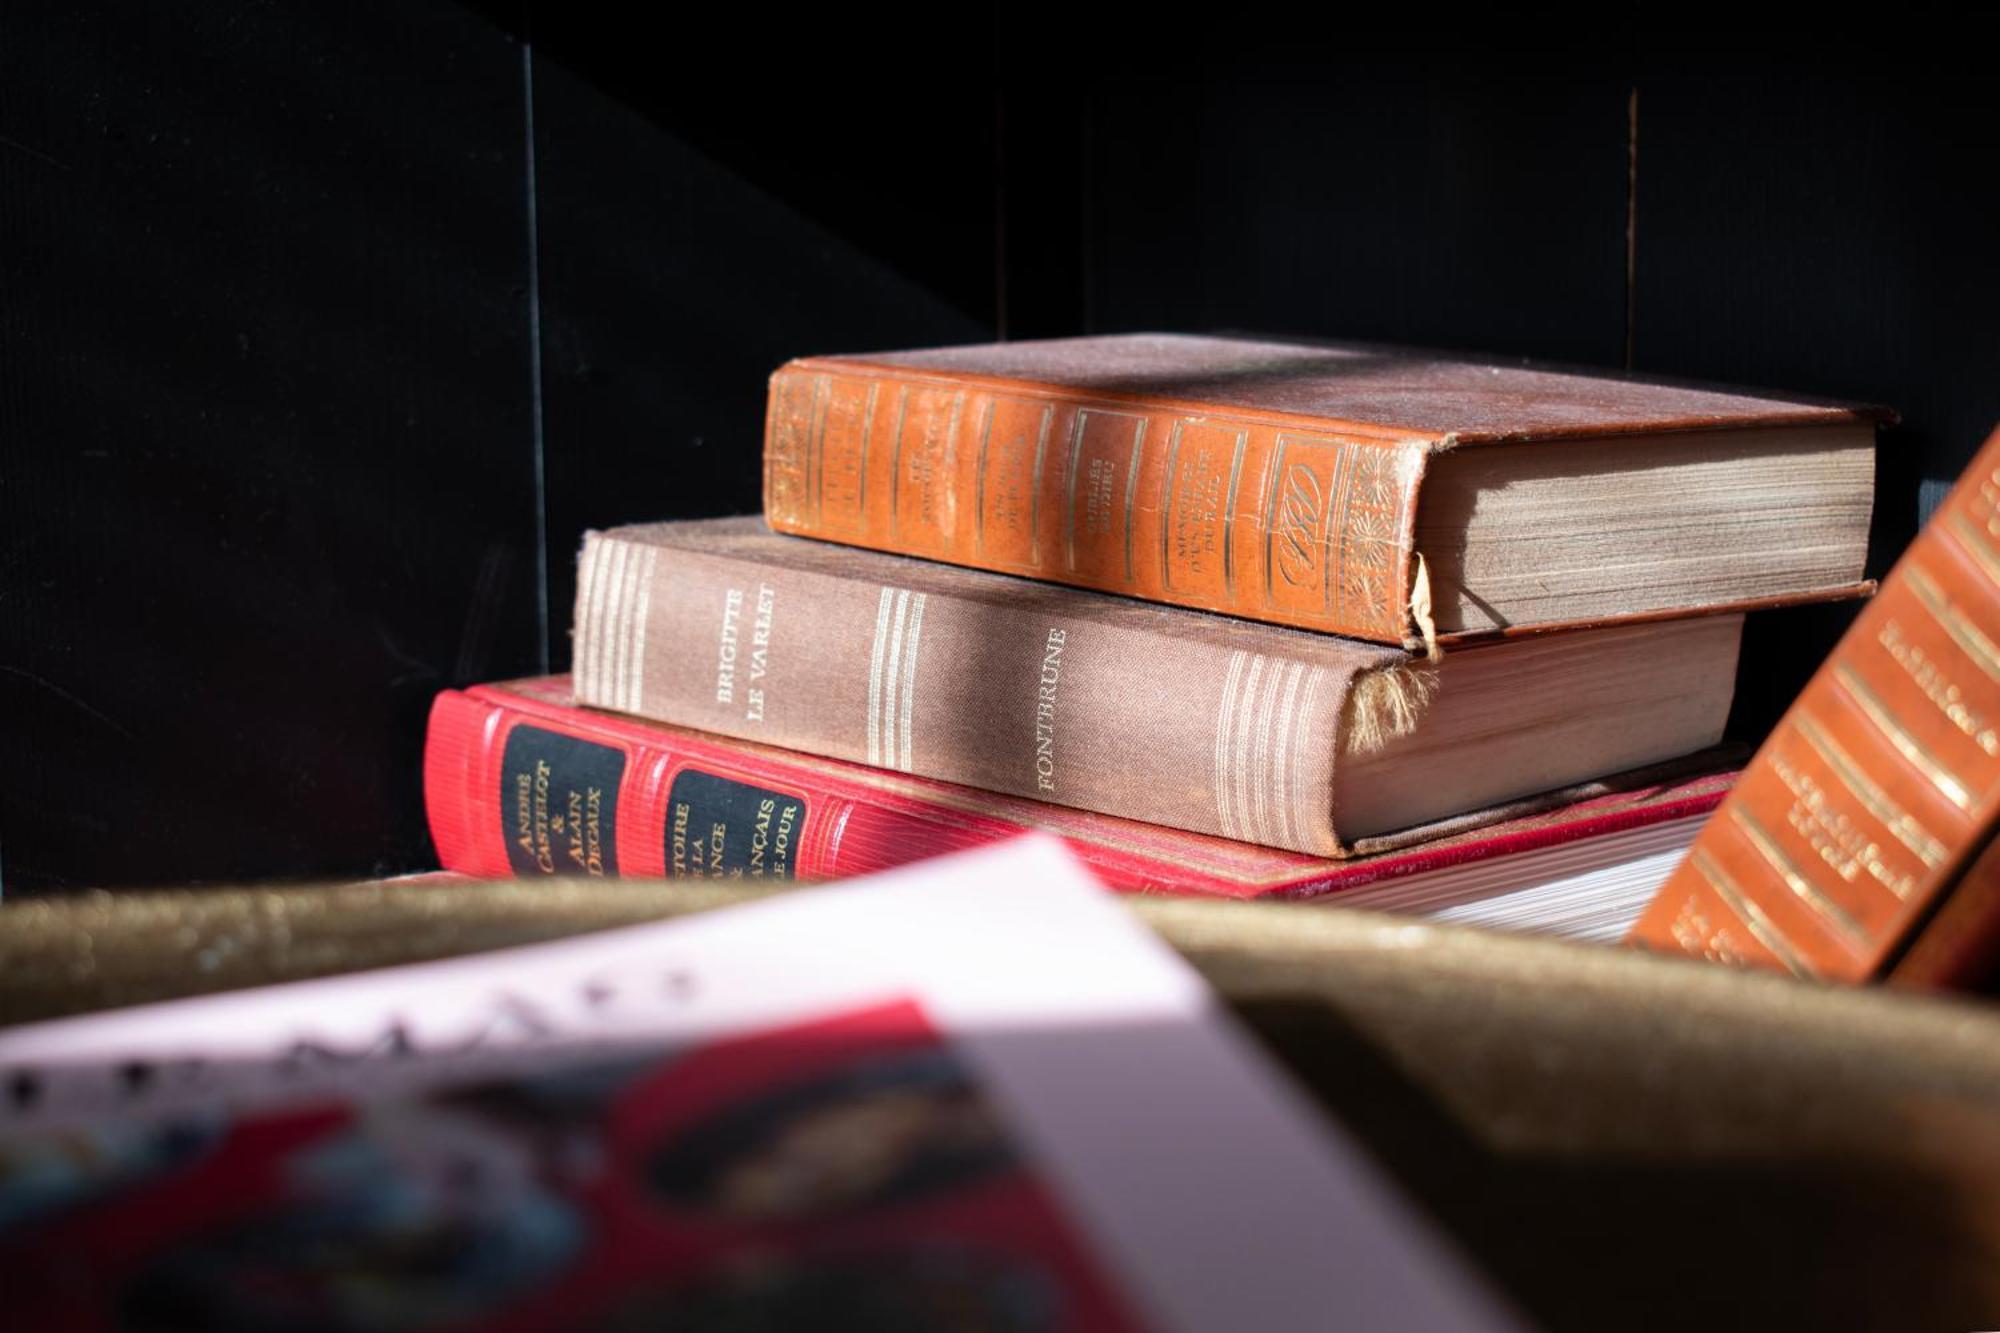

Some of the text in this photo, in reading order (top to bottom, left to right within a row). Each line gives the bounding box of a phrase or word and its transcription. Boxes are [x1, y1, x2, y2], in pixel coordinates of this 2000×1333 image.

[716, 587, 743, 705] BRIGITTE
[747, 582, 775, 722] LE VARLET
[1036, 628, 1066, 792] FONTBRUNE
[535, 759, 555, 873] CASTELOT
[552, 814, 565, 834] &
[568, 789, 586, 866] ALAIN
[587, 786, 604, 878] DECAUX
[673, 802, 690, 880] STOIRE
[692, 837, 704, 865] LA
[711, 822, 726, 878] ANCE
[751, 799, 775, 877] ANÇAIS
[775, 805, 797, 860] JOUR
